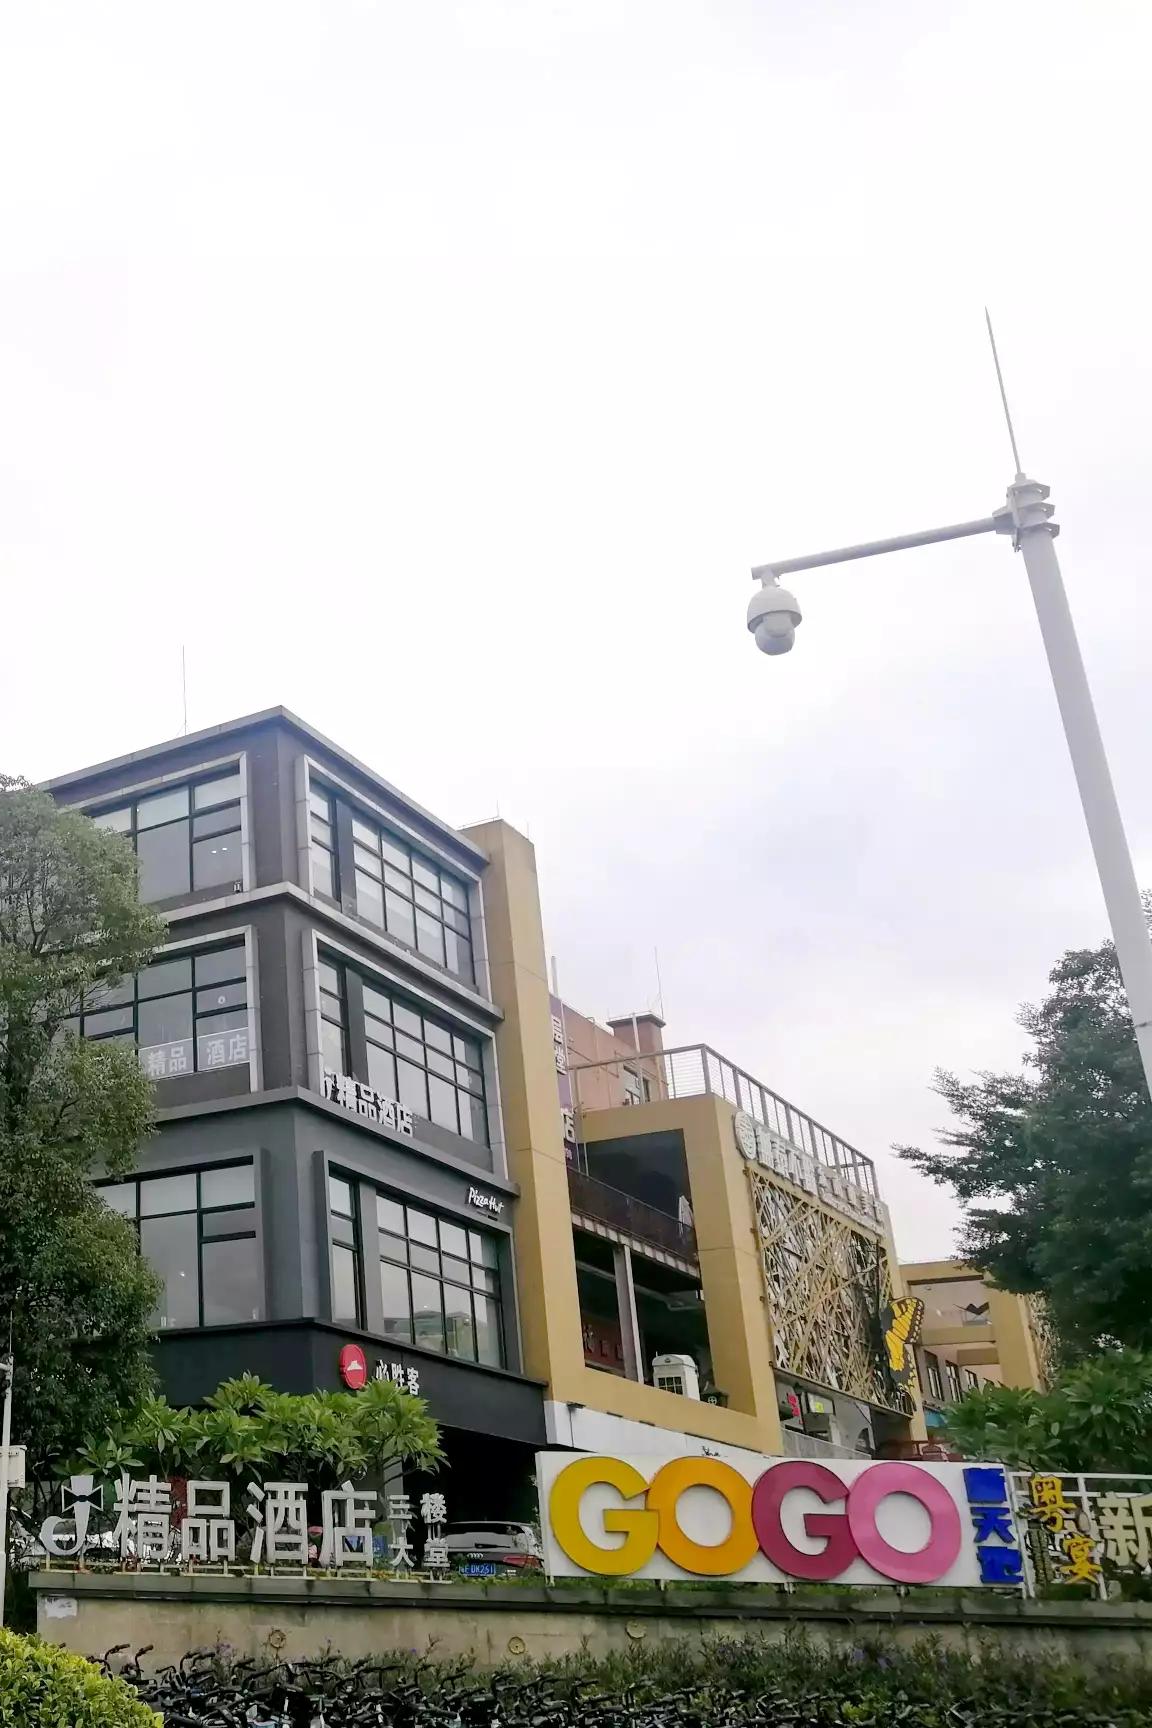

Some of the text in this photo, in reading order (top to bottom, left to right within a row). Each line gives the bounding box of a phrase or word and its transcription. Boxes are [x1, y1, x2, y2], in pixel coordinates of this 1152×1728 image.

[207, 1033, 248, 1066] 酒店
[336, 1072, 413, 1138] 精品酒店
[468, 1186, 505, 1214] Pizza Hut
[113, 1473, 378, 1570] 精品酒店
[550, 1456, 961, 1584] GOGO
[391, 1537, 450, 1568] 大堂
